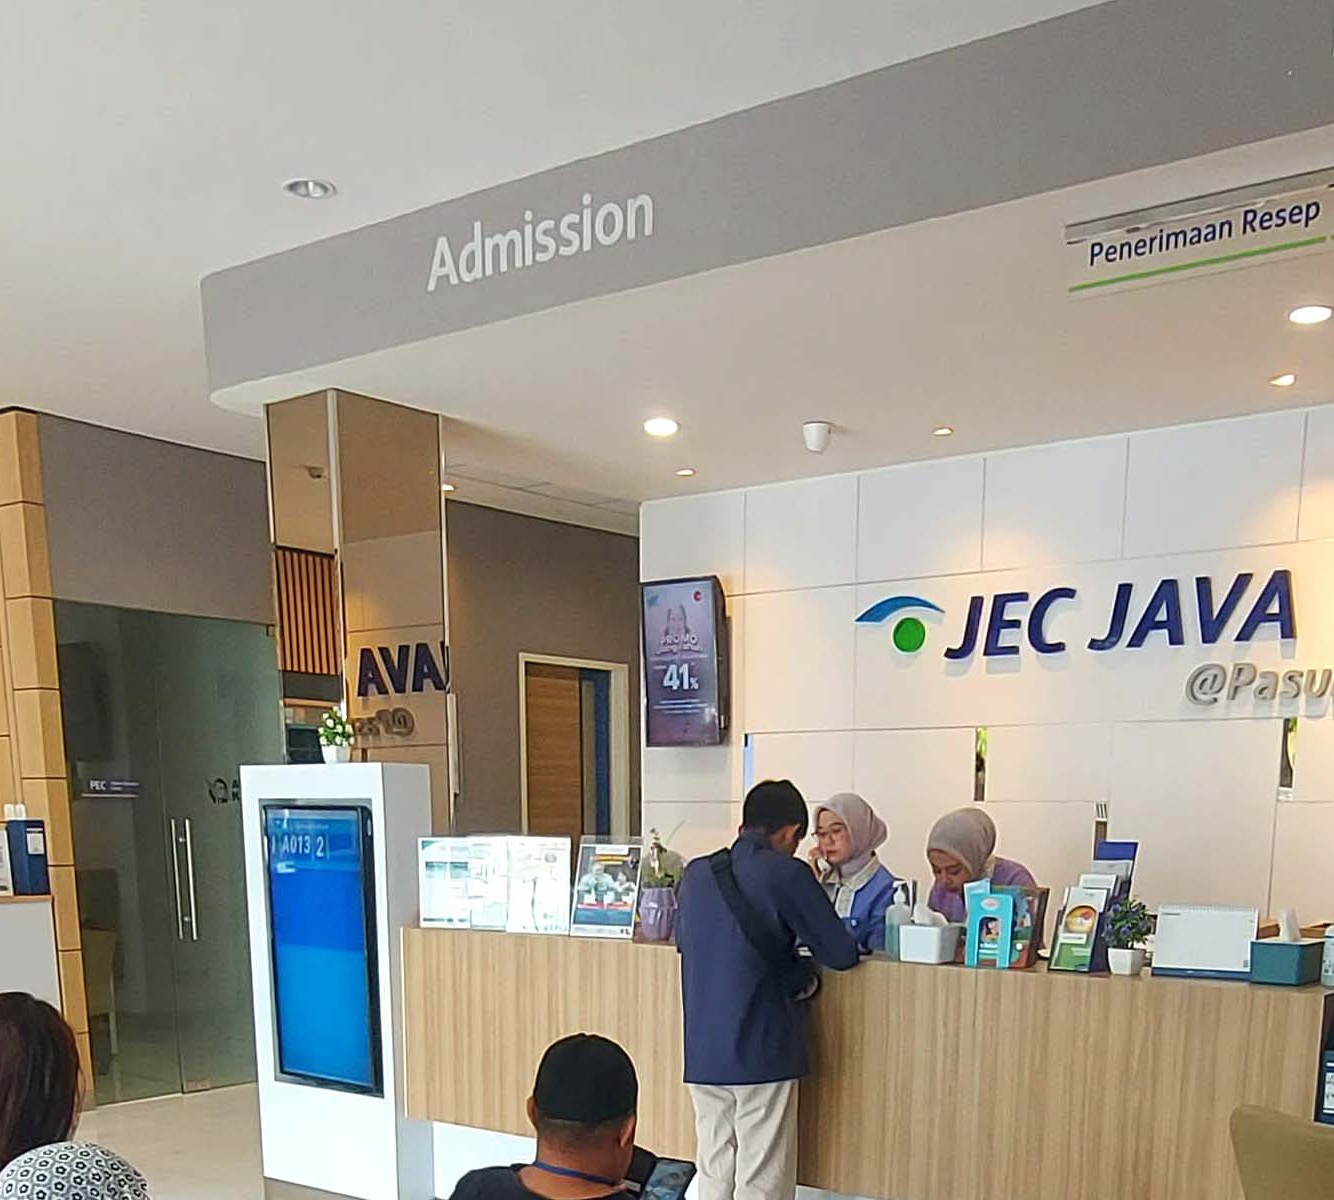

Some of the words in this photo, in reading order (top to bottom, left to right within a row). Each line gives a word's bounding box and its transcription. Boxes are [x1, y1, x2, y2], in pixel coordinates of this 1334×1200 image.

[427, 191, 655, 292] Admission
[1088, 215, 1234, 267] Penerimaan
[1240, 200, 1322, 239] Resep
[943, 586, 1077, 661] JEC
[1087, 568, 1298, 652] JAVA
